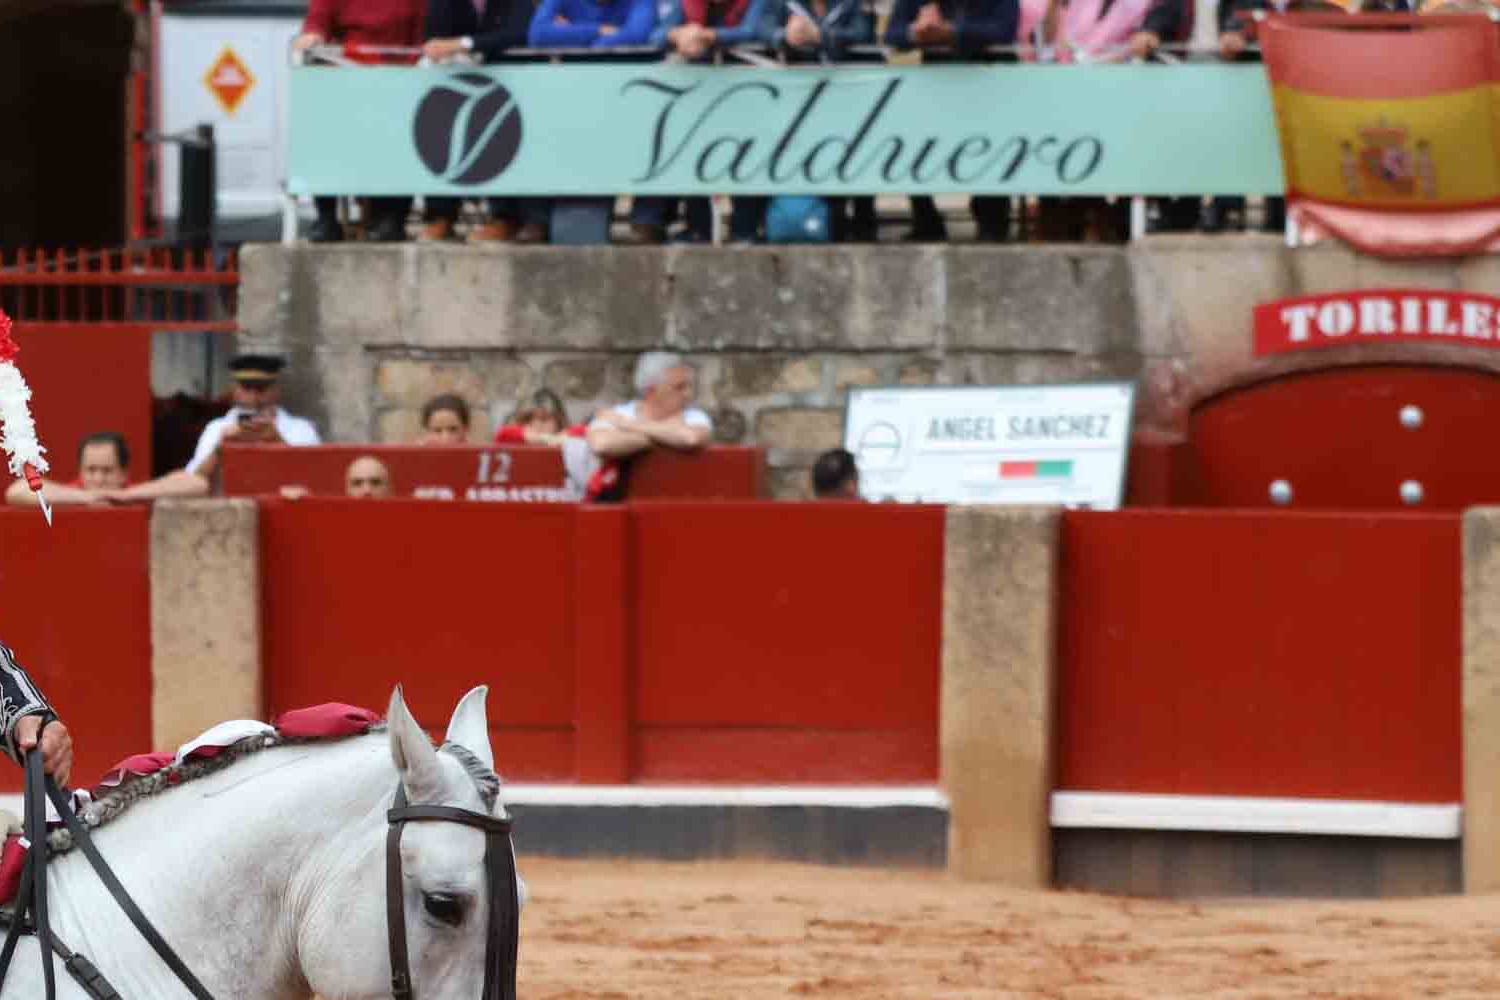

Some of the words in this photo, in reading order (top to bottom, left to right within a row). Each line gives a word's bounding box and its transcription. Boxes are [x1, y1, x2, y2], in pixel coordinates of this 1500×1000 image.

[620, 77, 1105, 184] Valduero
[1281, 297, 1500, 341] TORILE
[926, 416, 996, 440] ANGEL
[1006, 414, 1111, 438] SANCHEZ
[478, 452, 511, 483] 12
